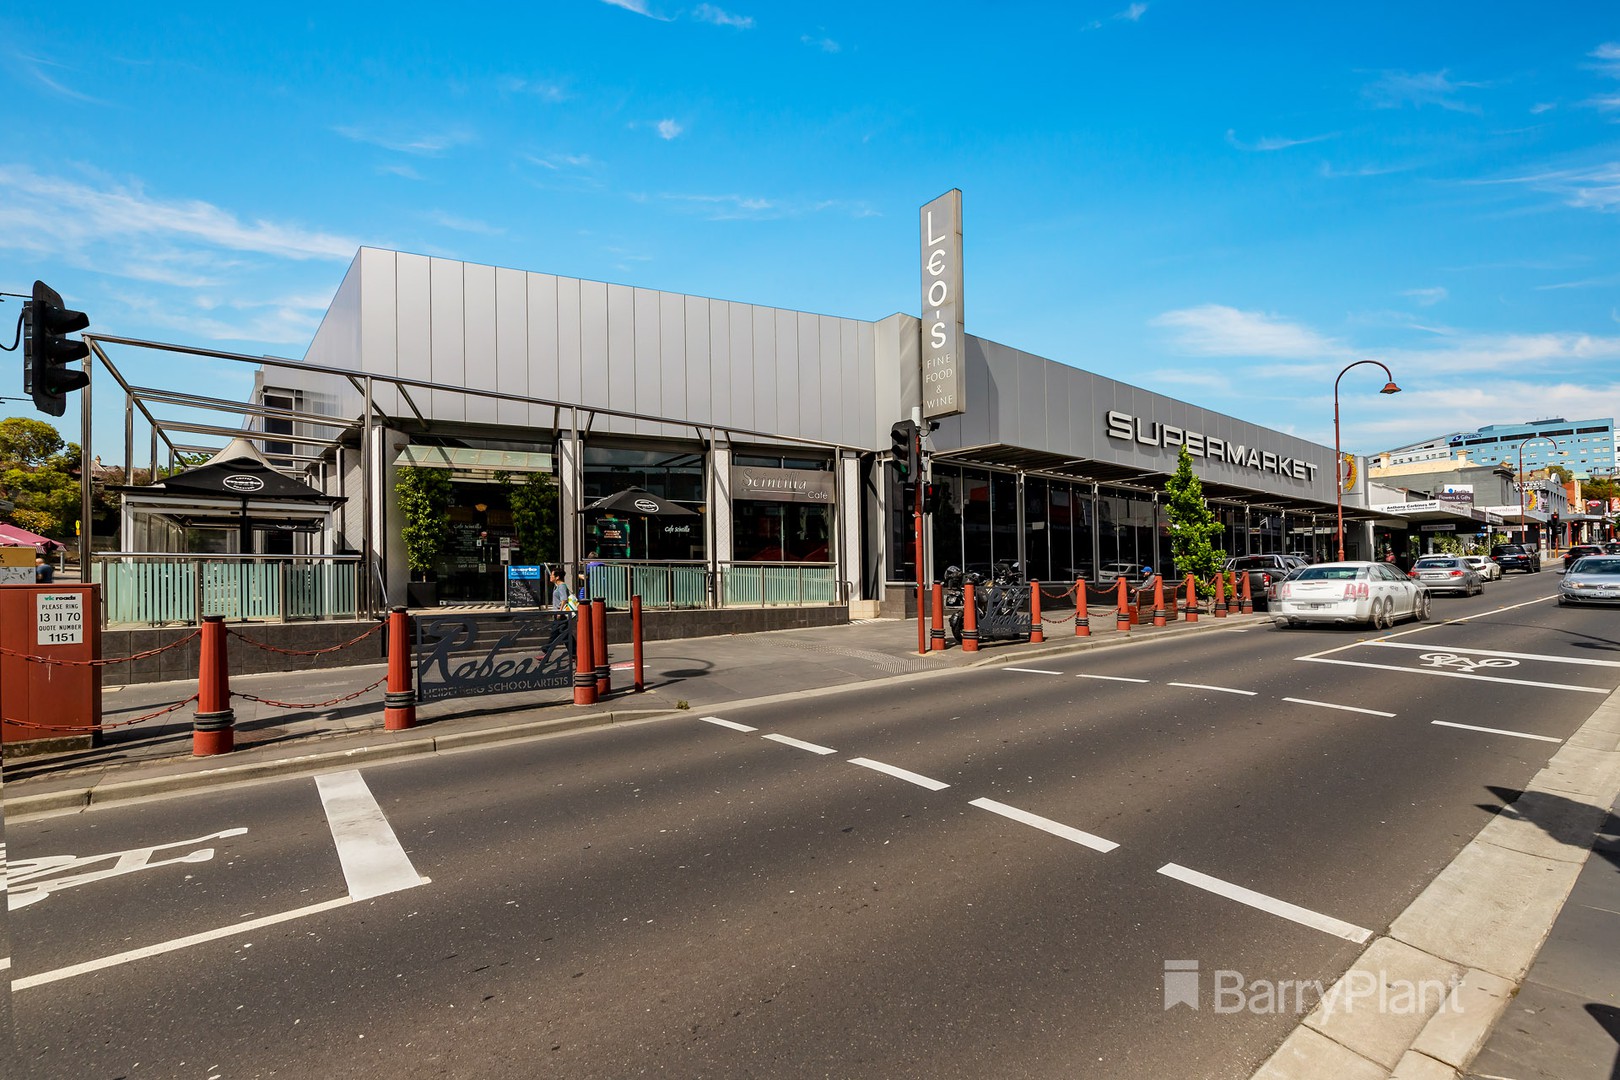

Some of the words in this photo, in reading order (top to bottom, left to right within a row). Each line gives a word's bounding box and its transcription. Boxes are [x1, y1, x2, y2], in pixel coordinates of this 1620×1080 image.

[926, 353, 952, 370] FINE
[925, 368, 953, 384] FOOD
[935, 384, 943, 395] &
[926, 395, 953, 410] WINE
[1106, 410, 1318, 482] SUPERMARKET
[39, 613, 51, 622] 13
[55, 613, 63, 622] 11
[67, 612, 81, 621] 70
[49, 633, 75, 642] 1151
[487, 680, 532, 693] SCHOOL
[533, 676, 569, 688] ARTISTS
